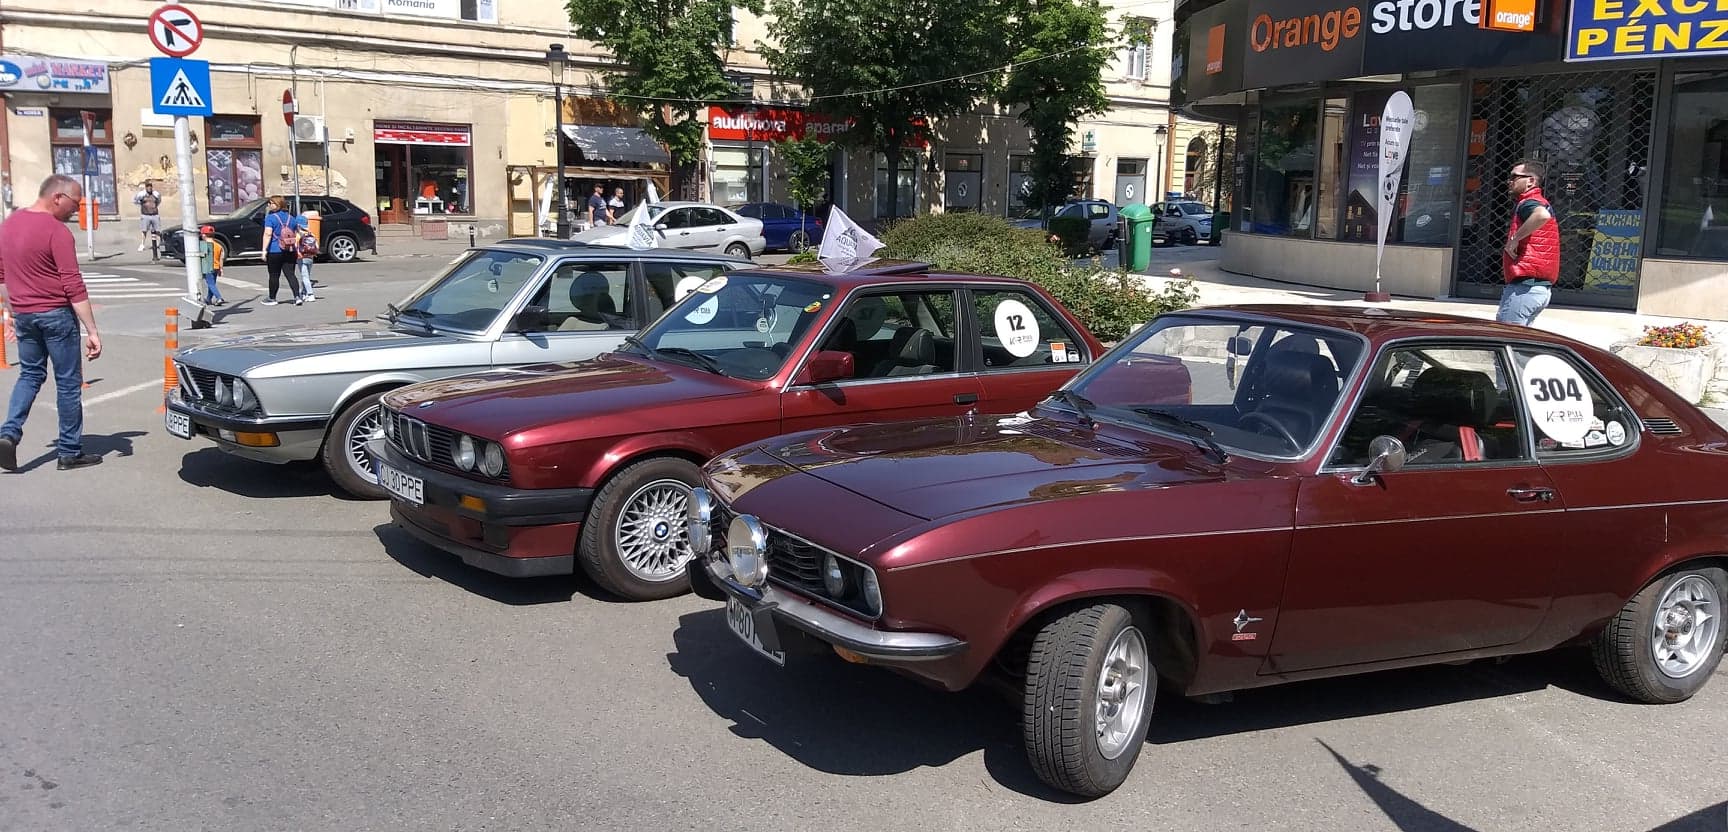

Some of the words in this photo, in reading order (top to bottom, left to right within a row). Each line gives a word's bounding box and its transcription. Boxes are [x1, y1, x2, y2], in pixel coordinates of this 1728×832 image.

[1251, 6, 1361, 53] Orange
[1371, 0, 1481, 34] store
[1496, 12, 1531, 27] orange
[51, 62, 105, 80] MARKET
[713, 114, 786, 132] audionova
[1385, 147, 1399, 160] Love
[1006, 314, 1026, 332] 12
[1530, 377, 1583, 402] 304
[401, 474, 422, 500] PPE
